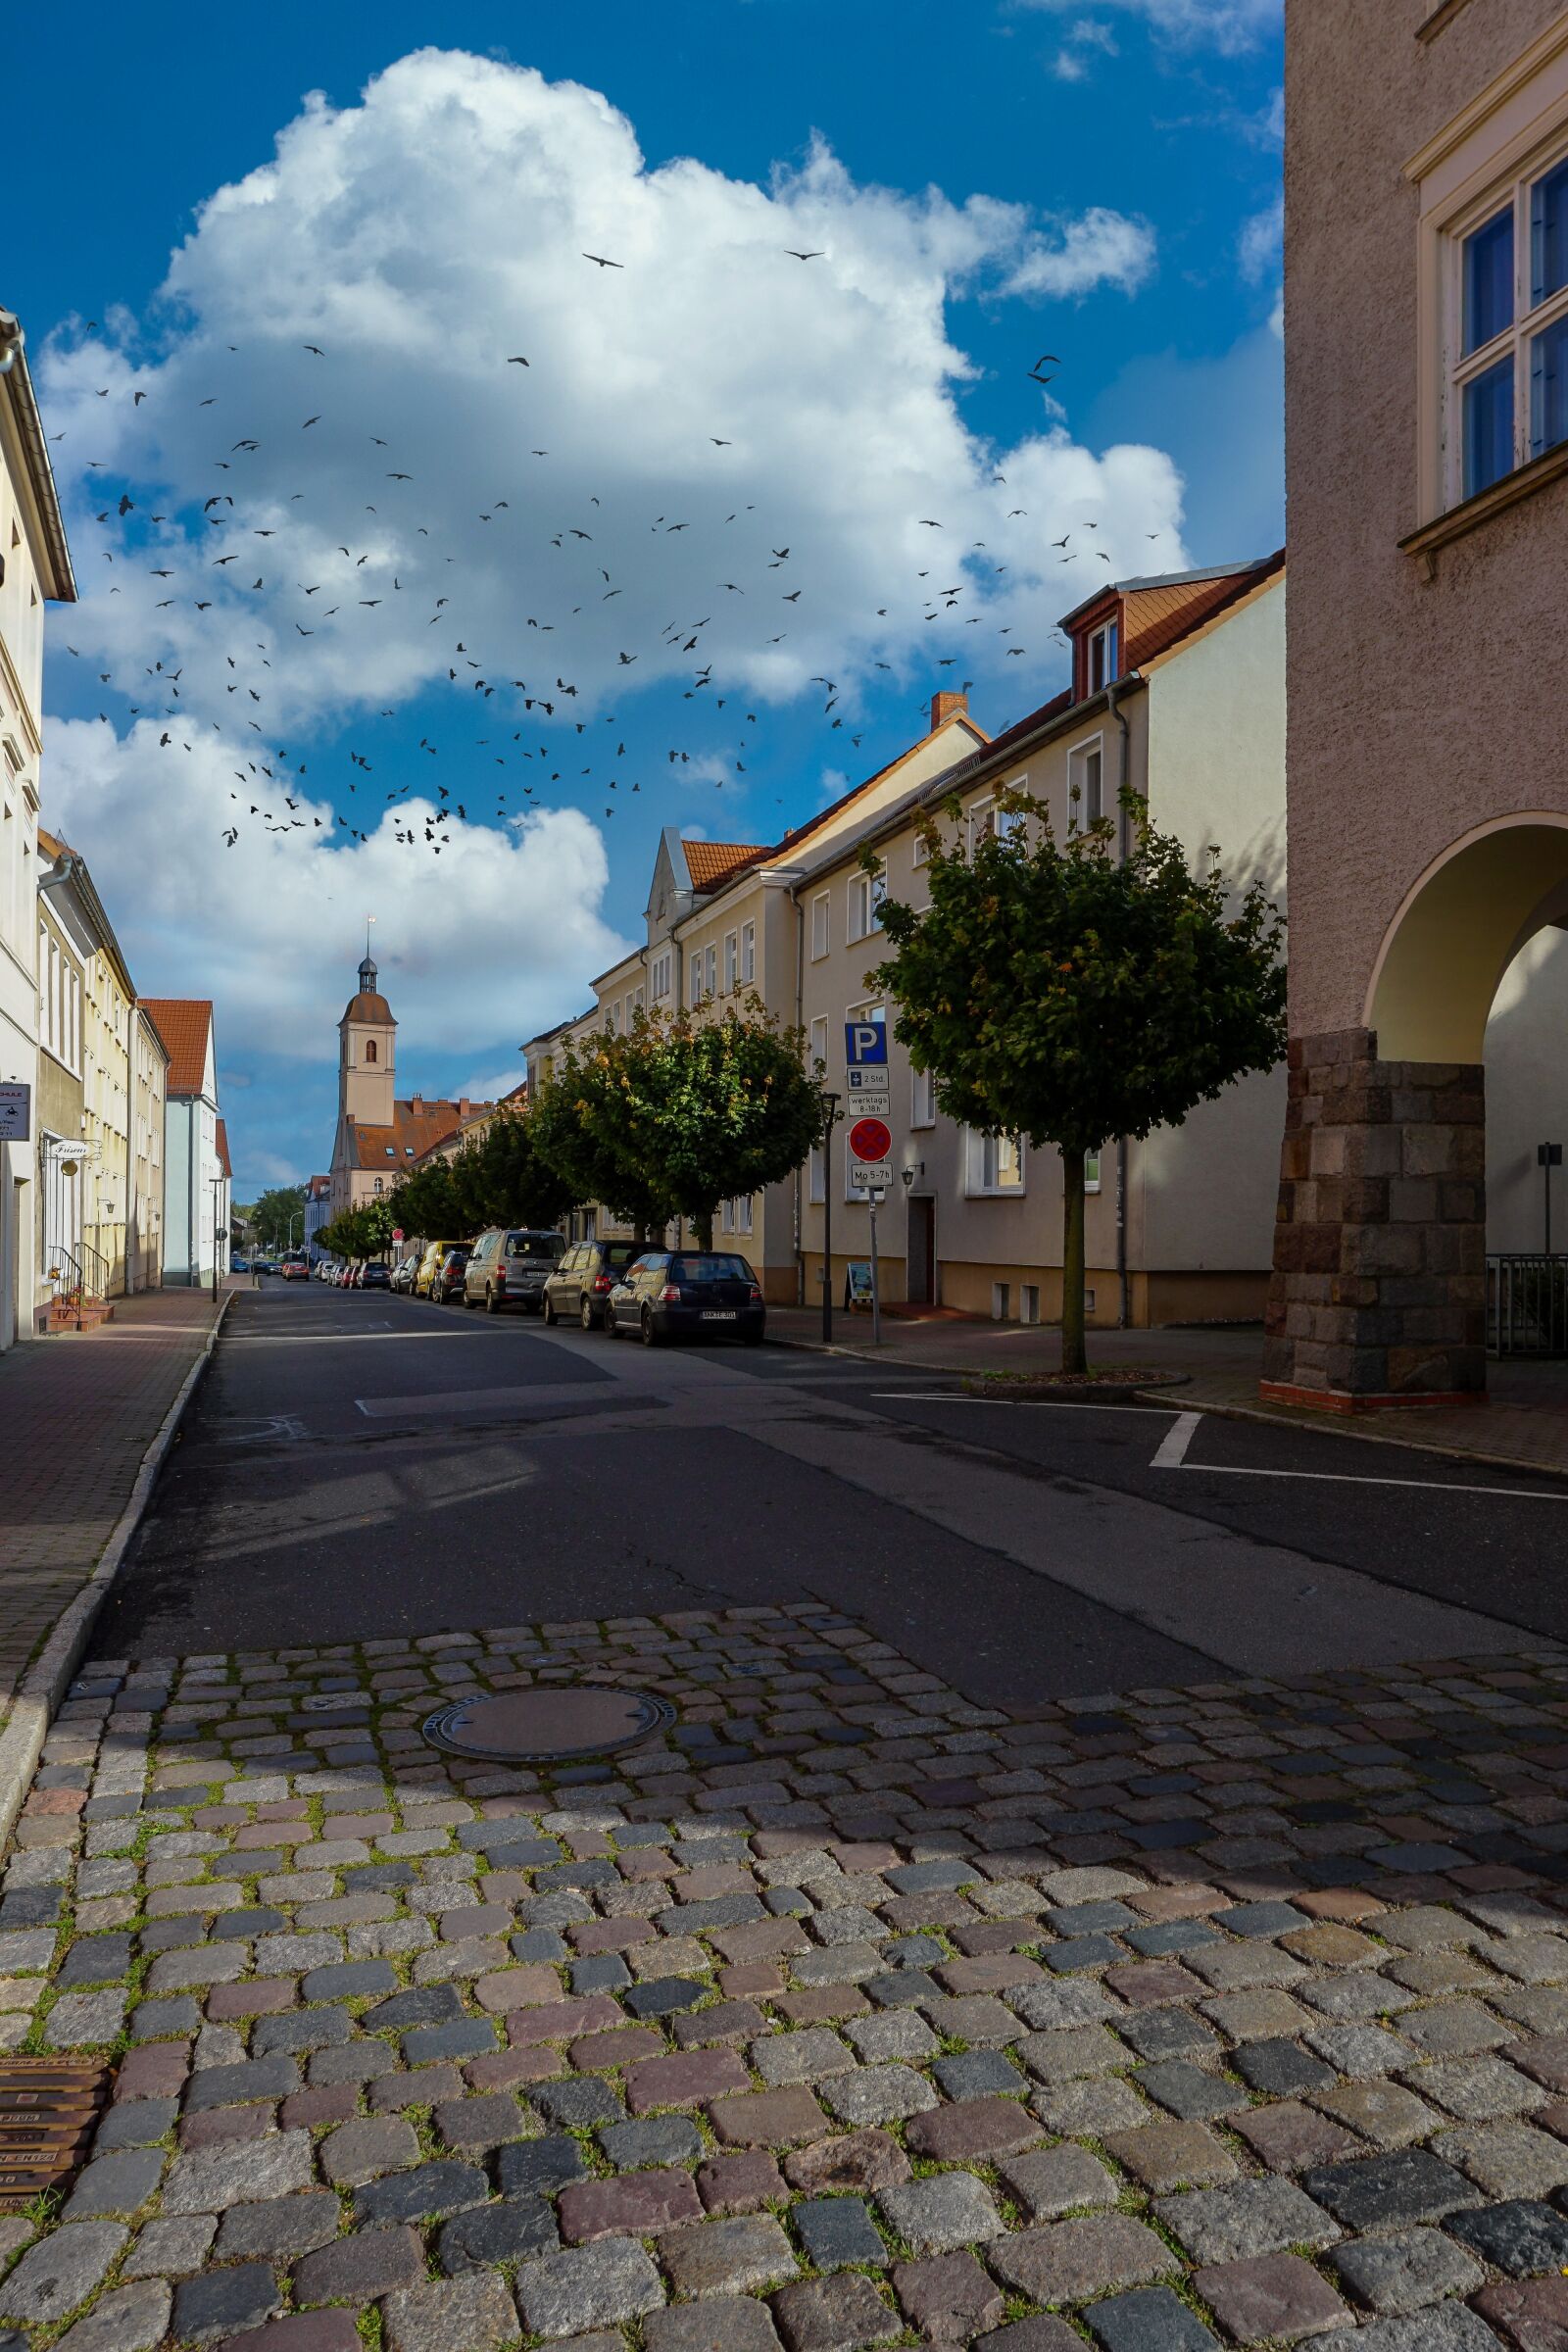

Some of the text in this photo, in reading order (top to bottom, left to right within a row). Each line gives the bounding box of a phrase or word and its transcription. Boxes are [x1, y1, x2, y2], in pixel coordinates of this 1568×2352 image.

[854, 1027, 878, 1060] P
[55, 1144, 86, 1153] Friseur
[855, 1171, 868, 1180] Mo
